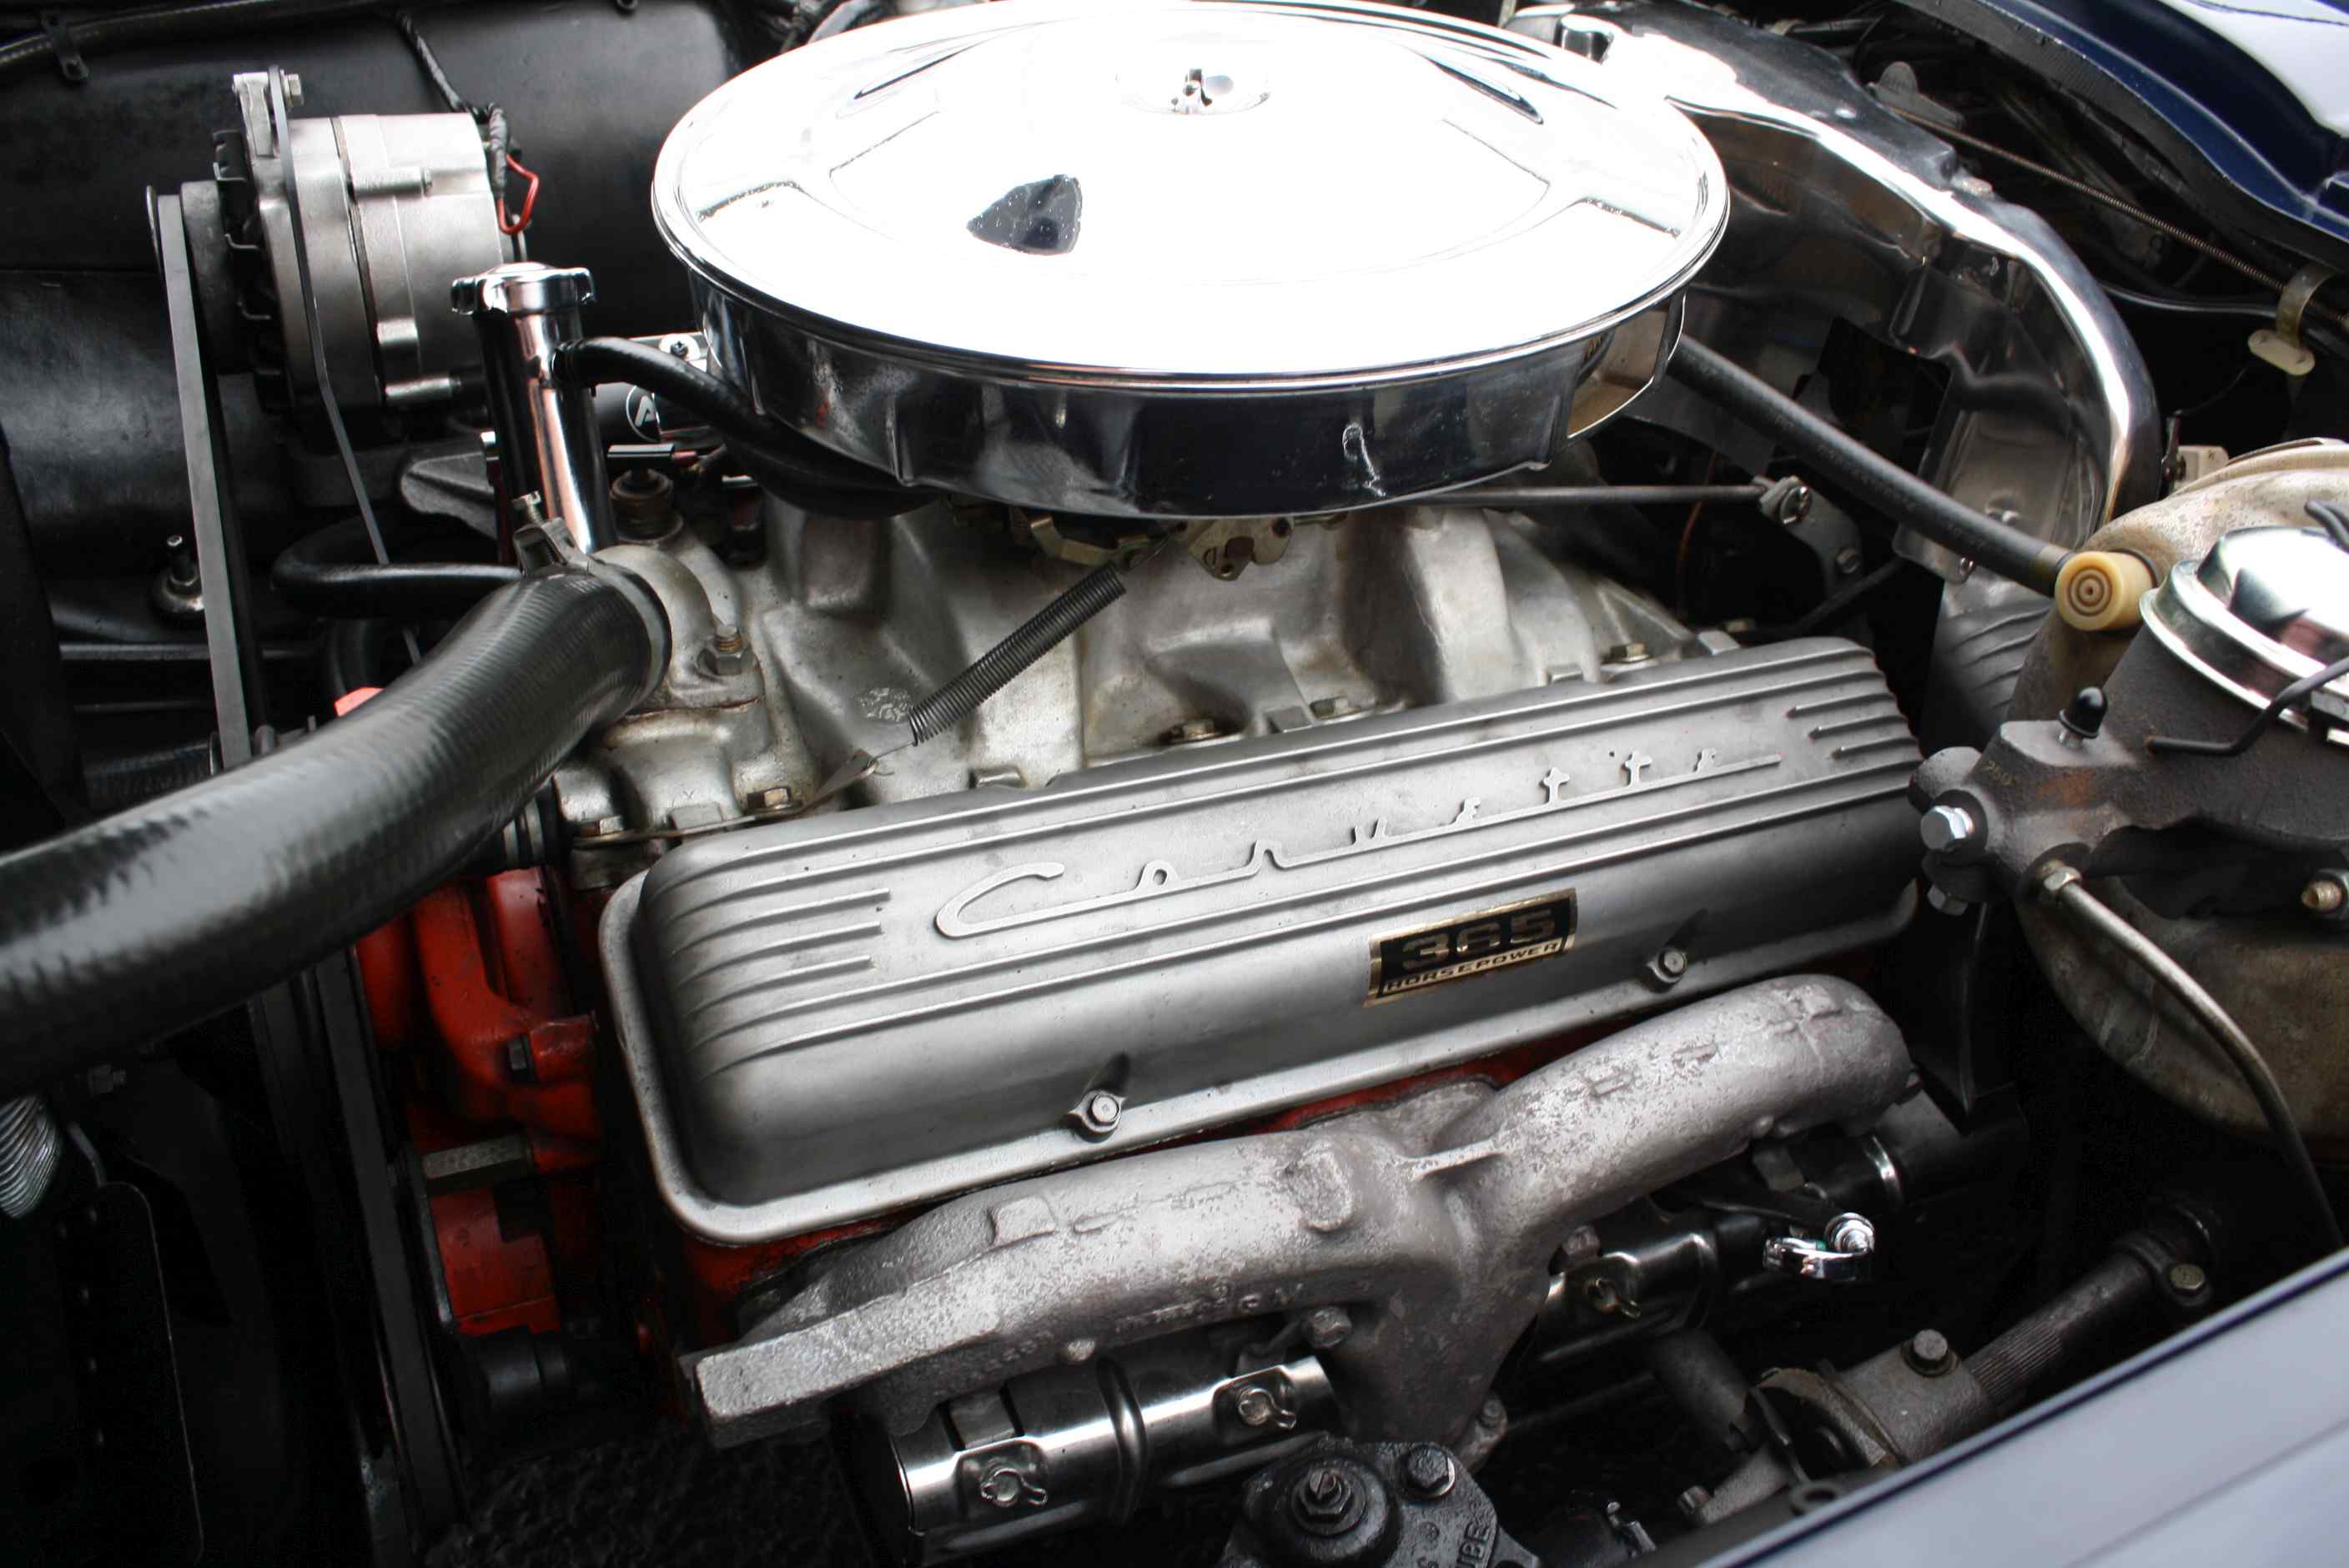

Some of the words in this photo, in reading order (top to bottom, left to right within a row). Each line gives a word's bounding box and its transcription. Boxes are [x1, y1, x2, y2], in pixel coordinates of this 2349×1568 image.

[936, 749, 1782, 939] Corvette
[1386, 942, 1559, 992] HORSEPOWER
[1403, 908, 1556, 970] 365
